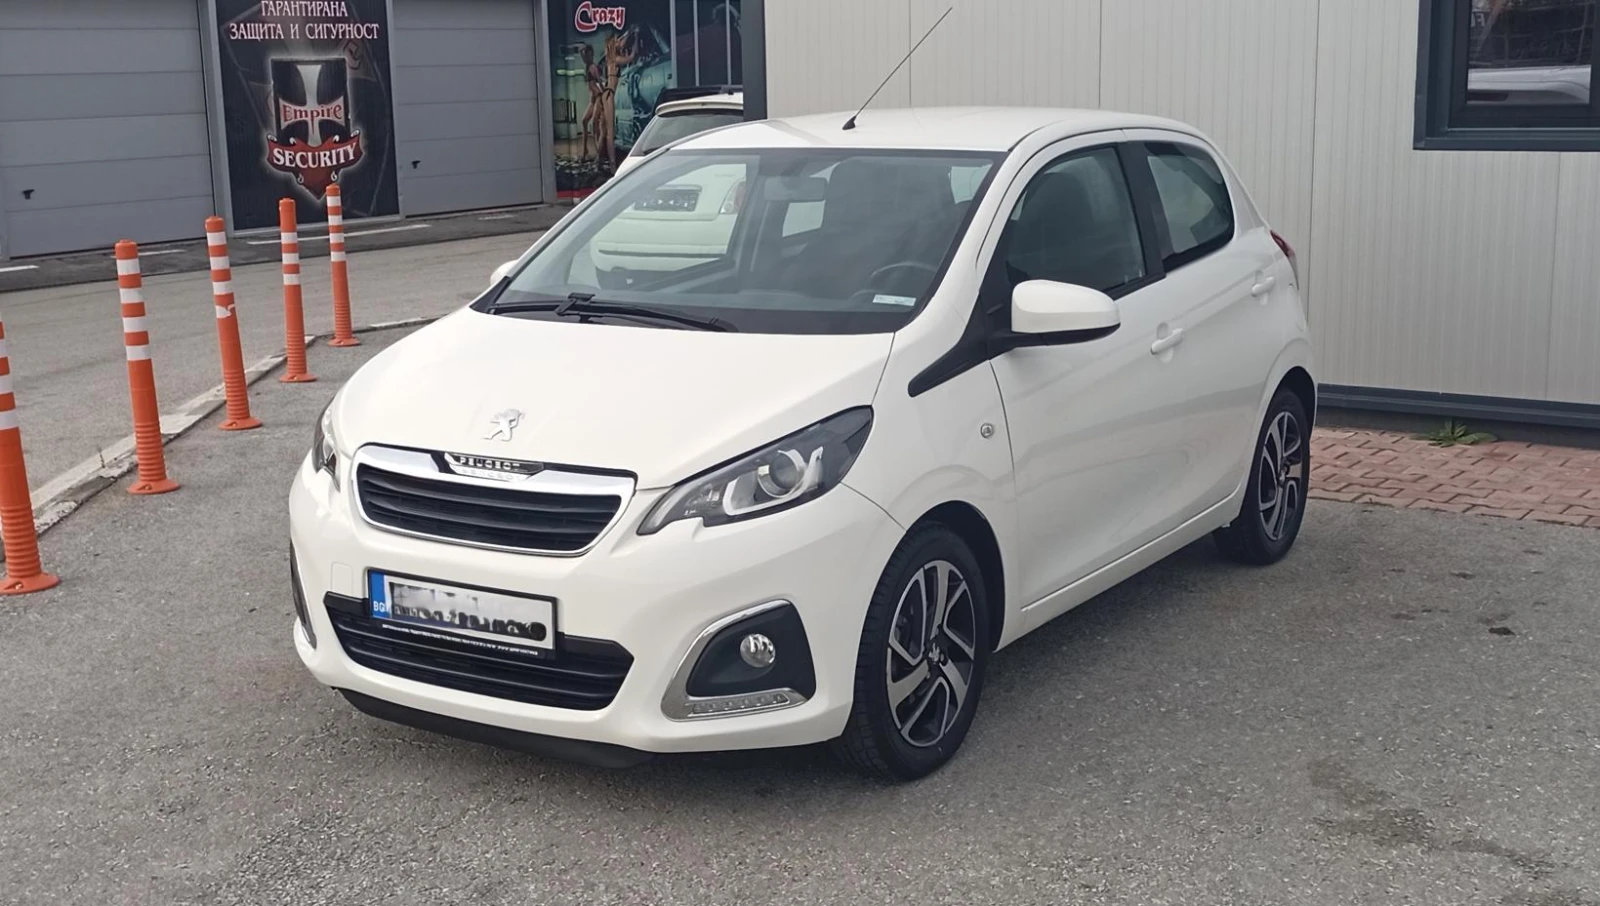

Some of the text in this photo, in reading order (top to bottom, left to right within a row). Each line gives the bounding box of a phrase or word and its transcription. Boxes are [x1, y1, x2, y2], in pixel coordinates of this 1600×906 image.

[261, 0, 348, 17] ГАРАНТИРАНА
[575, 1, 626, 33] Crazy
[229, 23, 380, 41] ЗАЩИТА И СИГУРНОСТ
[282, 103, 344, 135] Empire
[272, 143, 357, 169] SECURITY
[373, 600, 386, 613] BG
